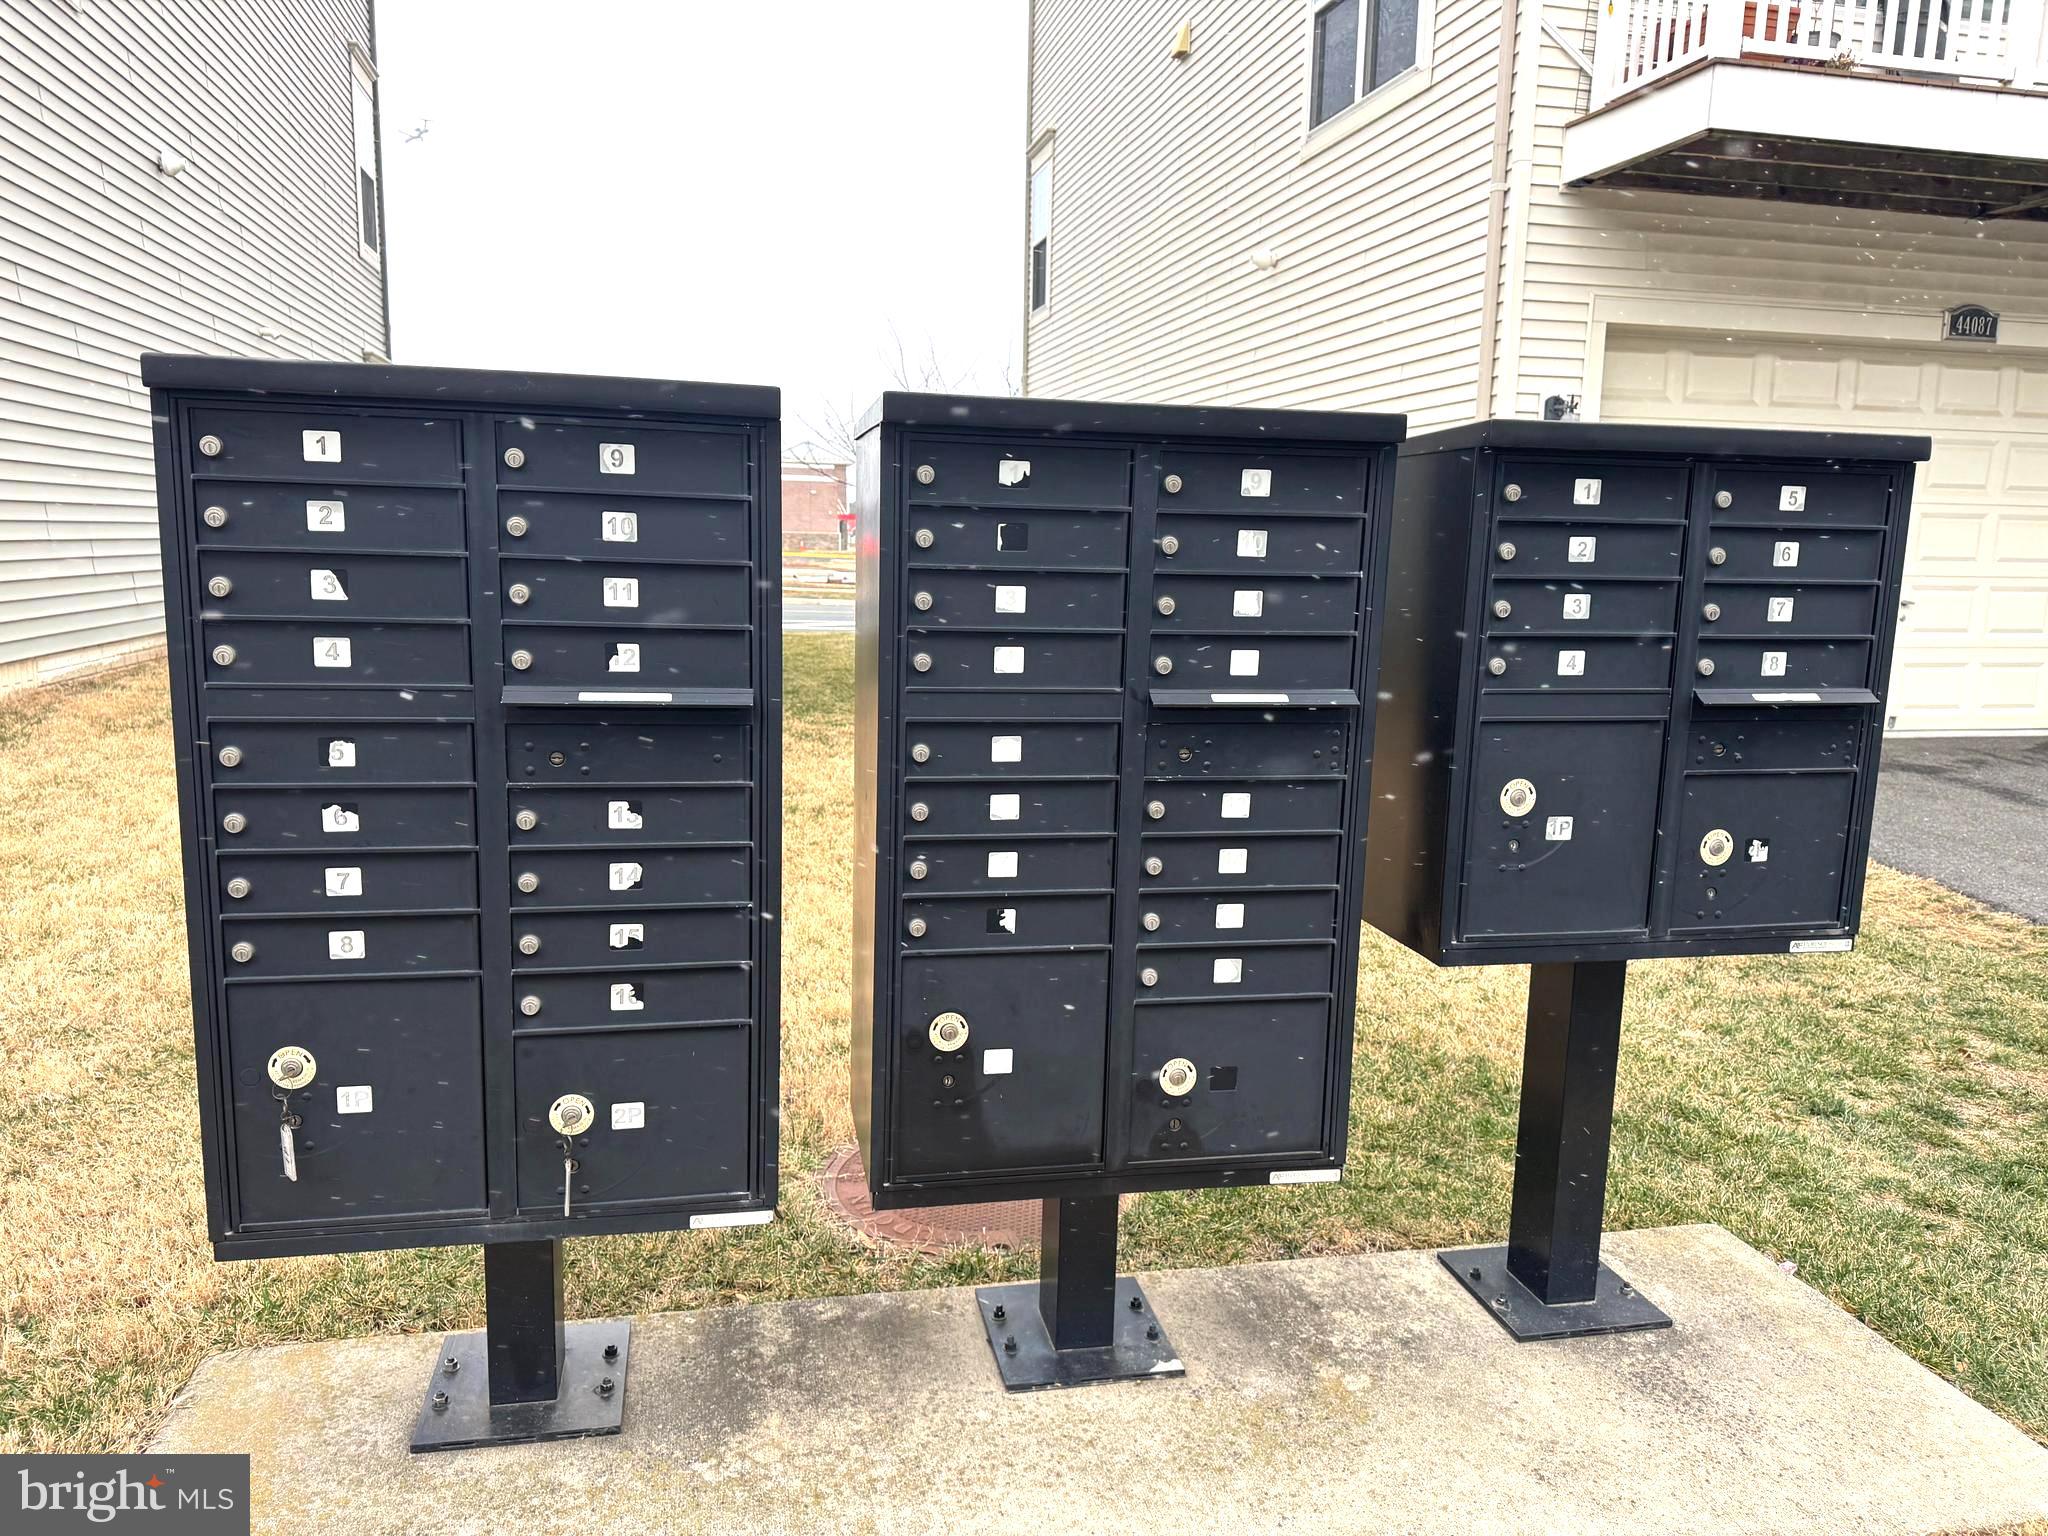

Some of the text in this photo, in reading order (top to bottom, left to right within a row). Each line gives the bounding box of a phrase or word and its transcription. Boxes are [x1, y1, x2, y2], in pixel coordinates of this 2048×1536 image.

[1956, 315, 1993, 335] 44087
[316, 436, 325, 455] 1
[611, 449, 623, 467] 9
[1251, 472, 1262, 490] 9
[1584, 484, 1591, 499] 1
[1788, 491, 1797, 505] 5
[320, 506, 332, 524] 2
[608, 517, 633, 535] 10
[1578, 542, 1587, 556] 2
[1782, 547, 1790, 561] 6
[323, 576, 336, 593] 3
[609, 583, 632, 600] 11
[1573, 599, 1581, 613] 3
[1777, 602, 1785, 616] 7
[325, 642, 339, 660] 4
[1567, 655, 1576, 670] 4
[1770, 657, 1778, 670] 8
[331, 742, 344, 760] 5
[334, 809, 347, 825] 6
[1550, 821, 1570, 835] 1P
[337, 873, 349, 889] 7
[614, 867, 639, 885] 14
[341, 936, 353, 953] 8
